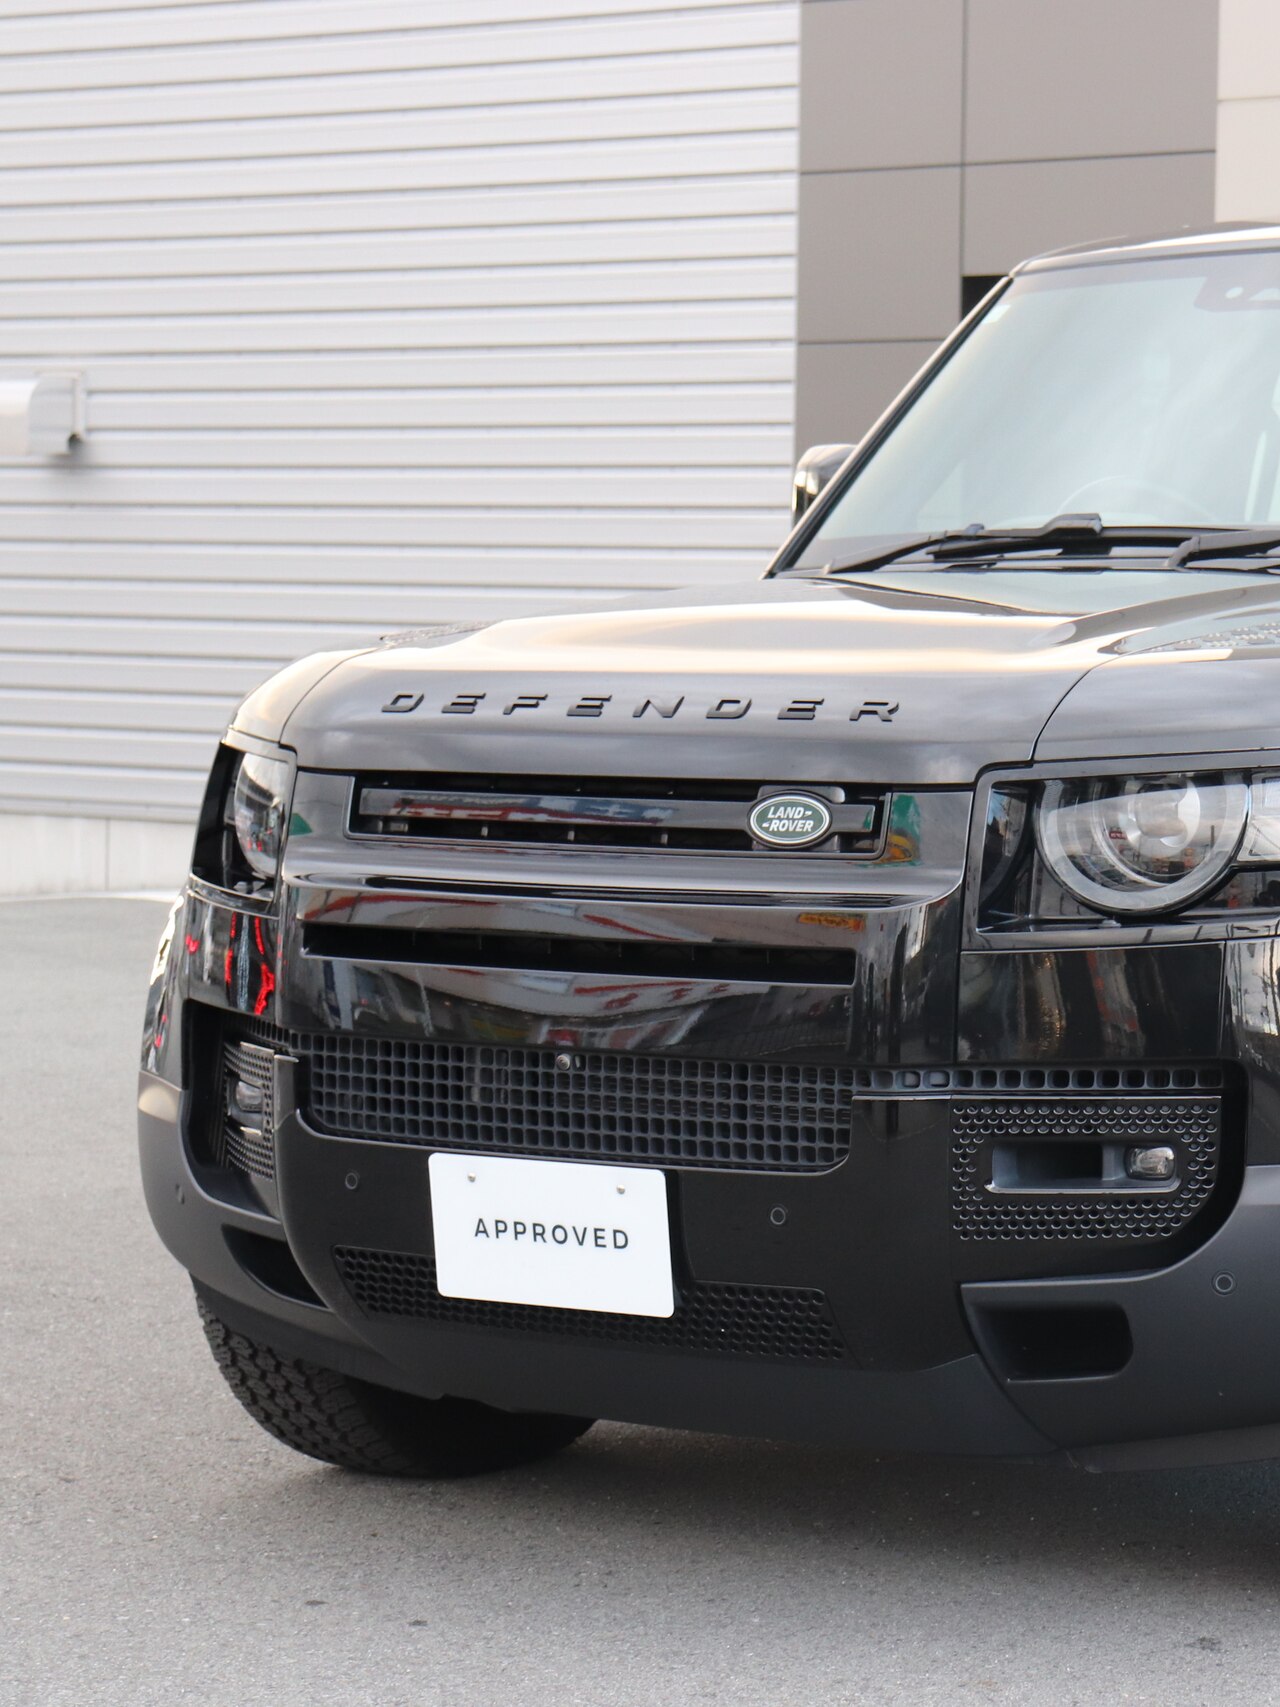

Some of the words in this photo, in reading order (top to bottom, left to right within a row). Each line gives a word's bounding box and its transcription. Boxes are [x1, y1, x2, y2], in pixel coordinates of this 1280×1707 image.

[381, 690, 899, 722] DEFENDER
[767, 806, 805, 819] LAND
[768, 820, 814, 832] ROVER
[474, 1217, 630, 1250] APPROVED
